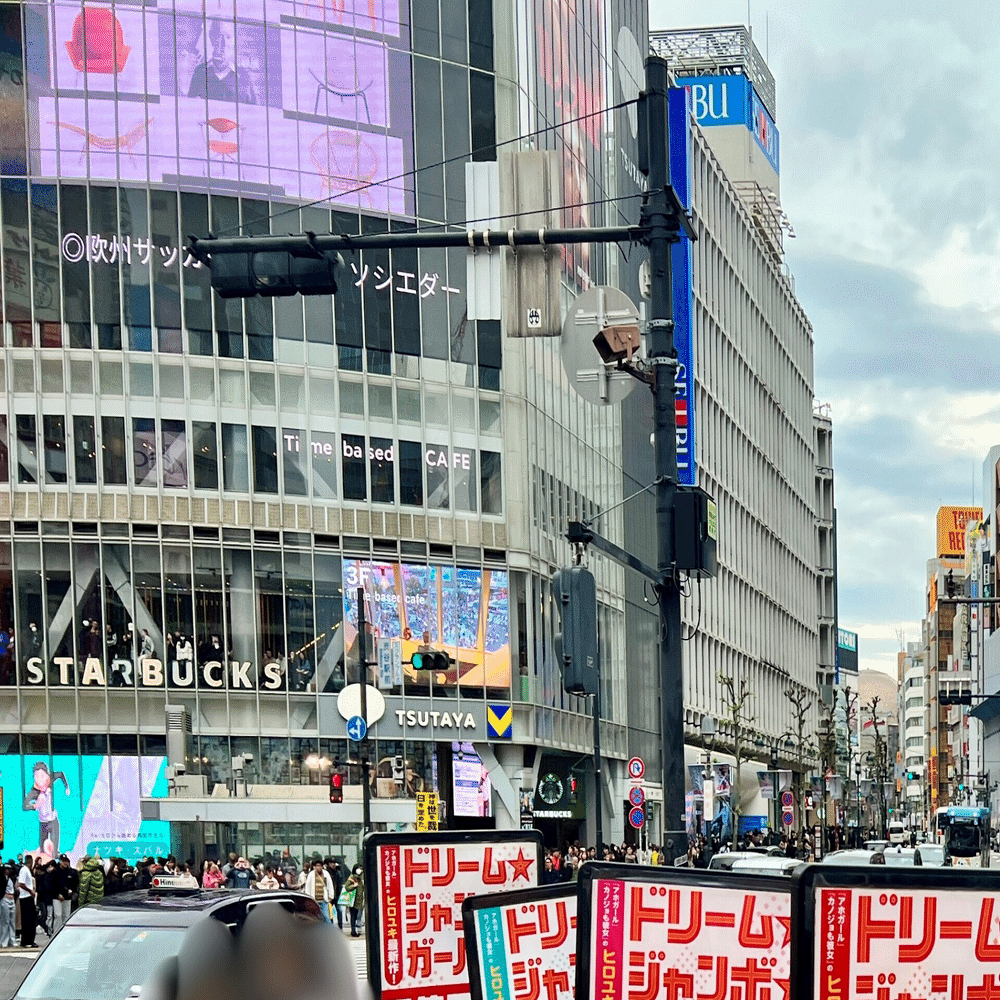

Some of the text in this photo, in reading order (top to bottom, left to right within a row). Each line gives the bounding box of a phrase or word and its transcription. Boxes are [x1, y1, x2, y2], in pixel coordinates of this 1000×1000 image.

[283, 434, 470, 470] Time based CAFE
[346, 566, 371, 585] 3F
[405, 593, 426, 606] cafe
[26, 656, 282, 689] STARBUCKS
[396, 710, 476, 729] TSUTAYA
[404, 847, 507, 888] ドリーム
[629, 885, 774, 949] ドリーム
